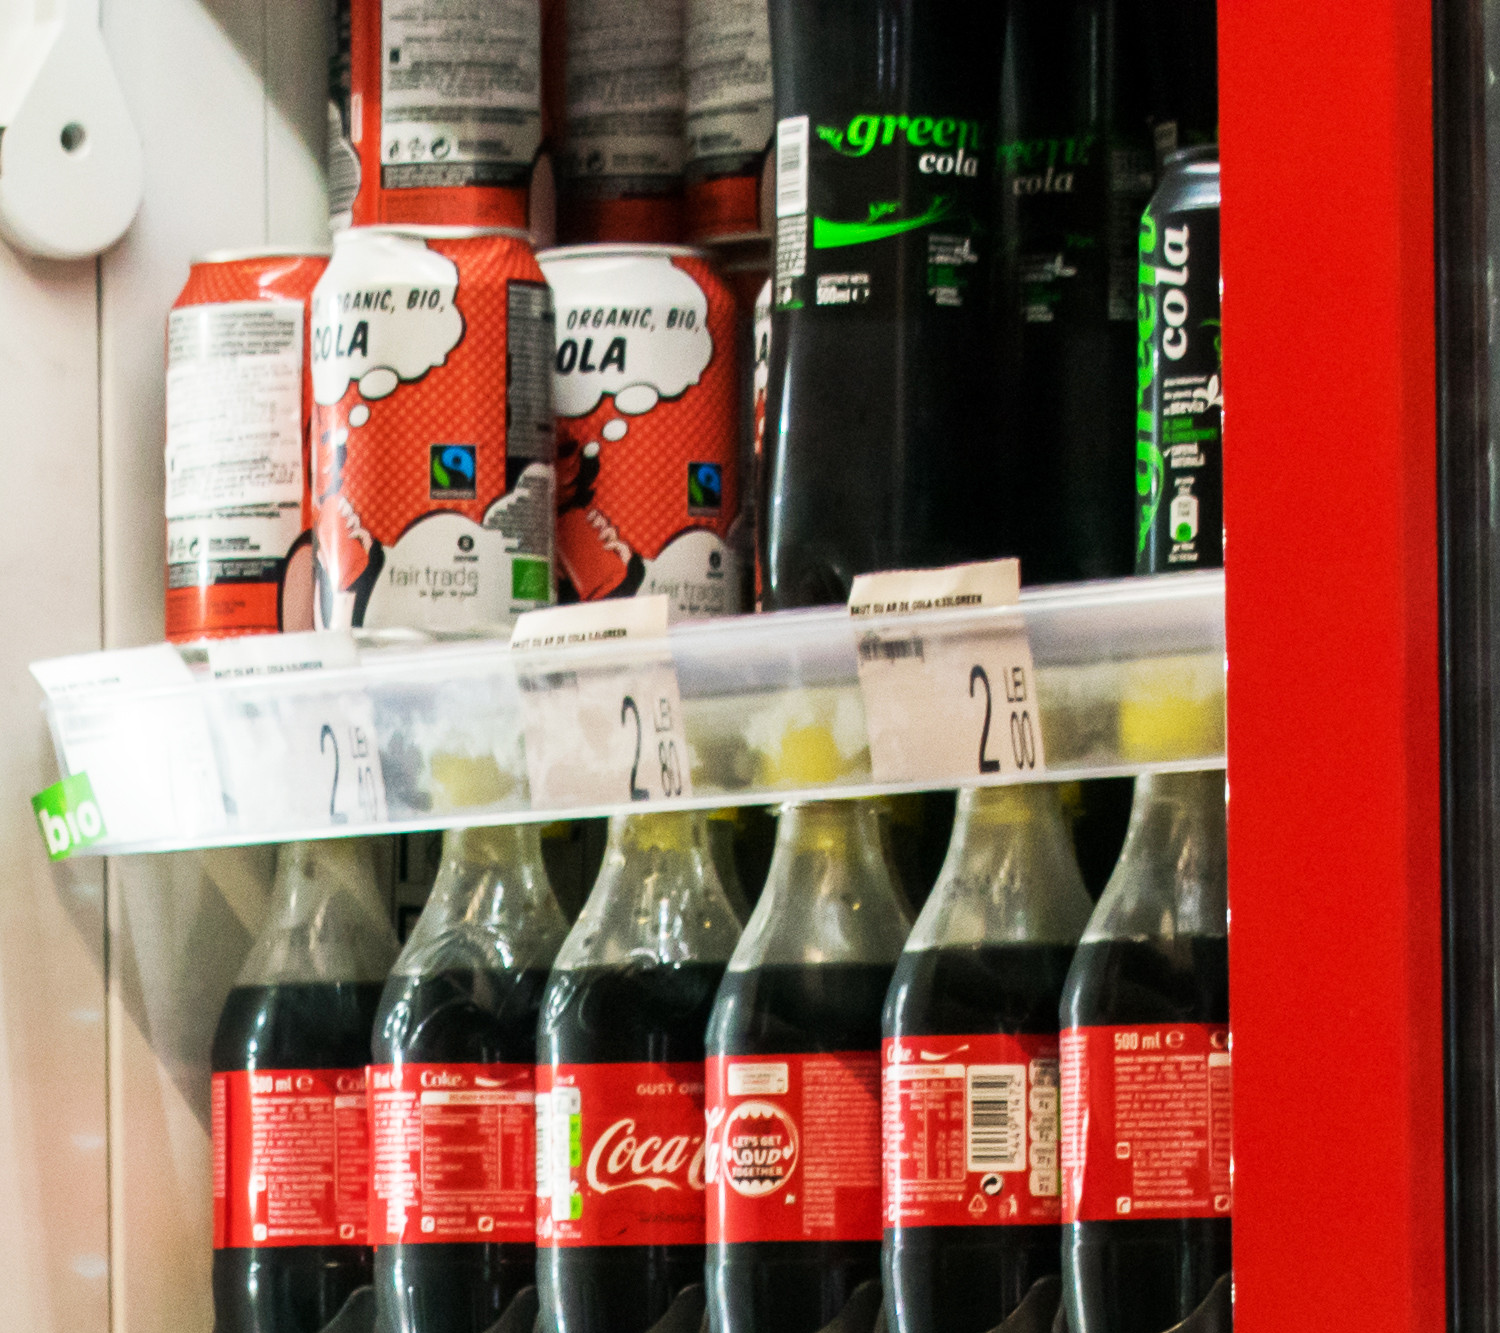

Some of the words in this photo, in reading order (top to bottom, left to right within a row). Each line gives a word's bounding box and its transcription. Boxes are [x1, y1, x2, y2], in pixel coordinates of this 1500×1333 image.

[838, 114, 980, 158] green
[918, 148, 979, 178] cola
[406, 288, 446, 313] BIO,
[1163, 223, 1190, 362] cola
[566, 307, 658, 332] ORGANIC,
[666, 307, 703, 332] BIO,
[555, 335, 628, 376] OLA
[389, 565, 421, 587] fair
[424, 565, 479, 587] trade
[969, 663, 1001, 774] 2
[1003, 665, 1028, 703] LEI
[620, 695, 649, 801] 2
[1008, 709, 1036, 771] 00
[321, 724, 348, 824] 2
[39, 799, 101, 854] bio
[1114, 1032, 1140, 1050] 500
[1142, 1031, 1160, 1050] ml
[420, 1069, 462, 1088] Coke
[586, 1118, 706, 1194] Coca-
[732, 1148, 783, 1166] LOUD
